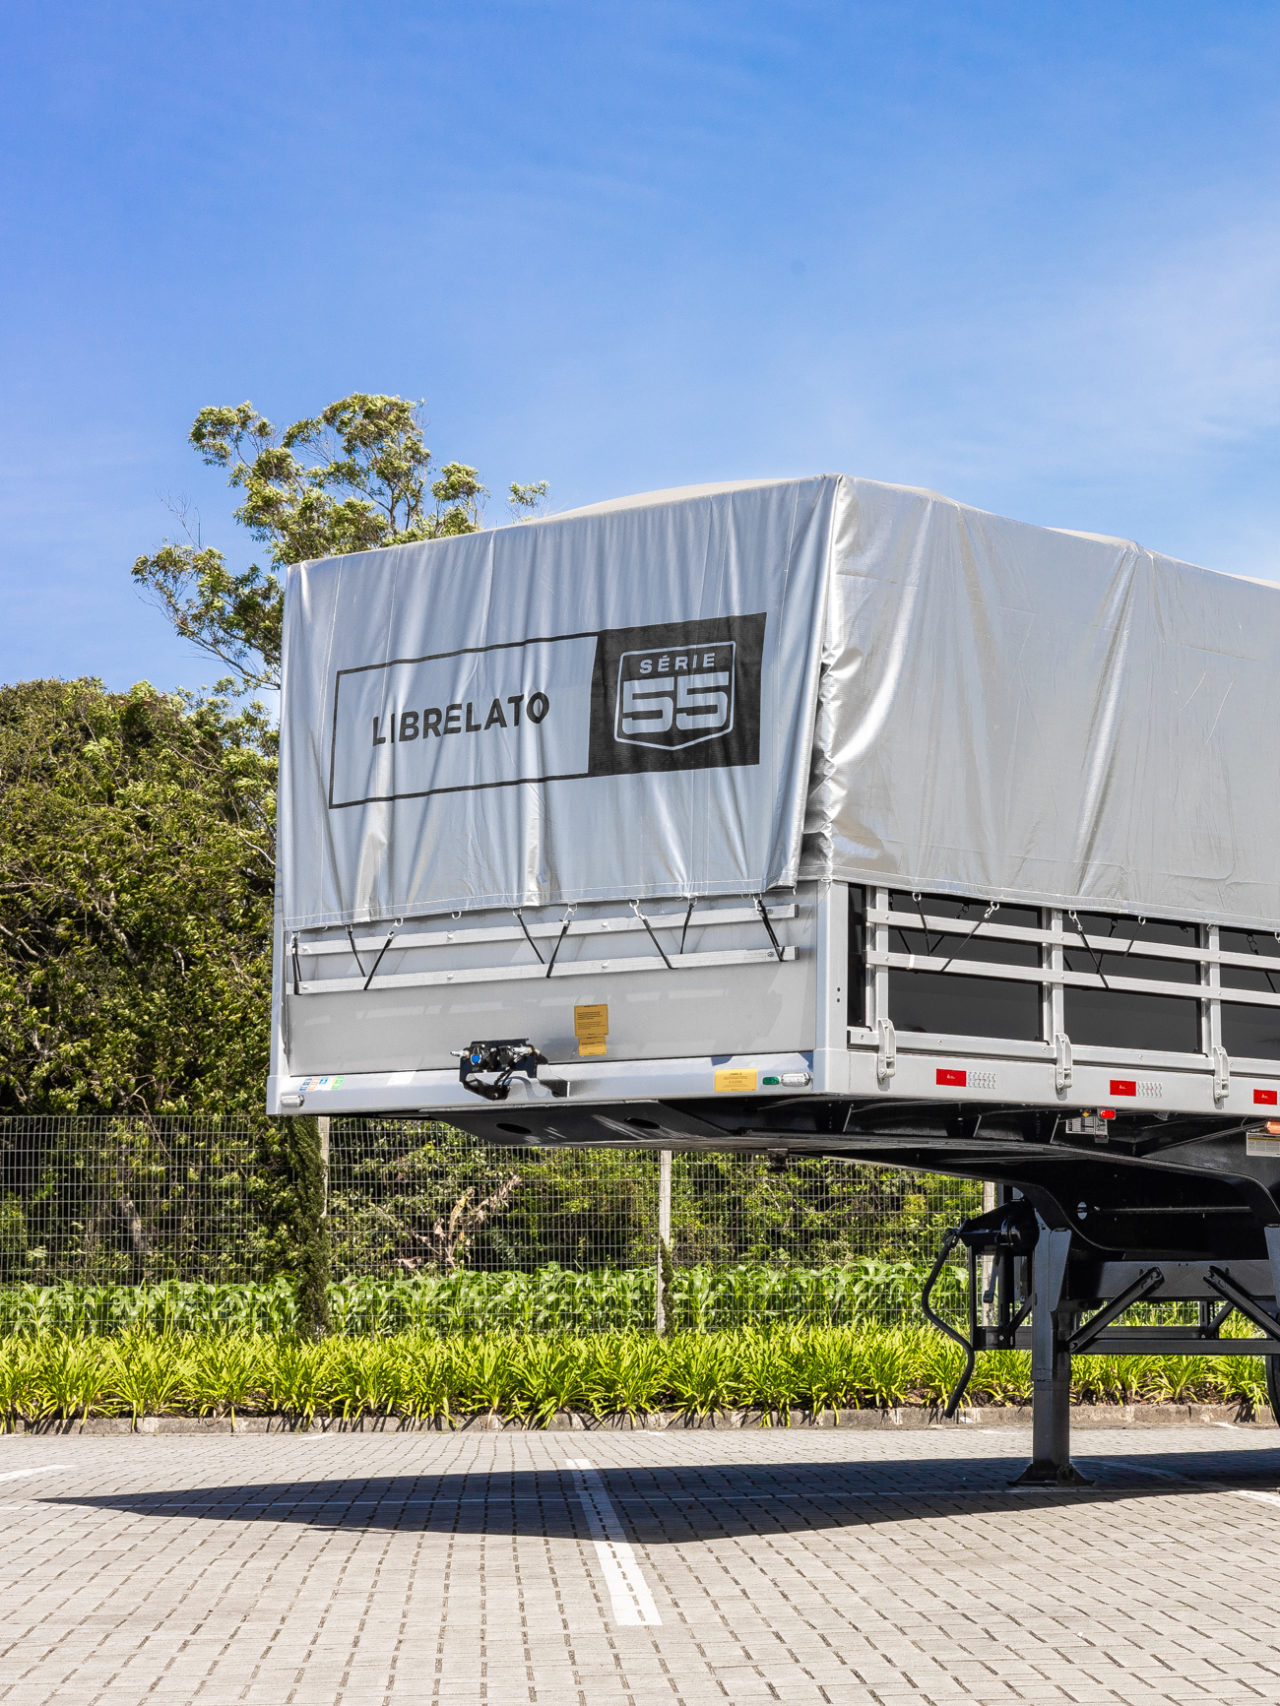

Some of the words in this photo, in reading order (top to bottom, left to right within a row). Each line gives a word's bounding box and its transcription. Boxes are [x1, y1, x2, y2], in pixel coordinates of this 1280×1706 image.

[640, 653, 716, 674] SÉRIE
[373, 691, 550, 747] LIBRELATO
[622, 671, 729, 735] 55
